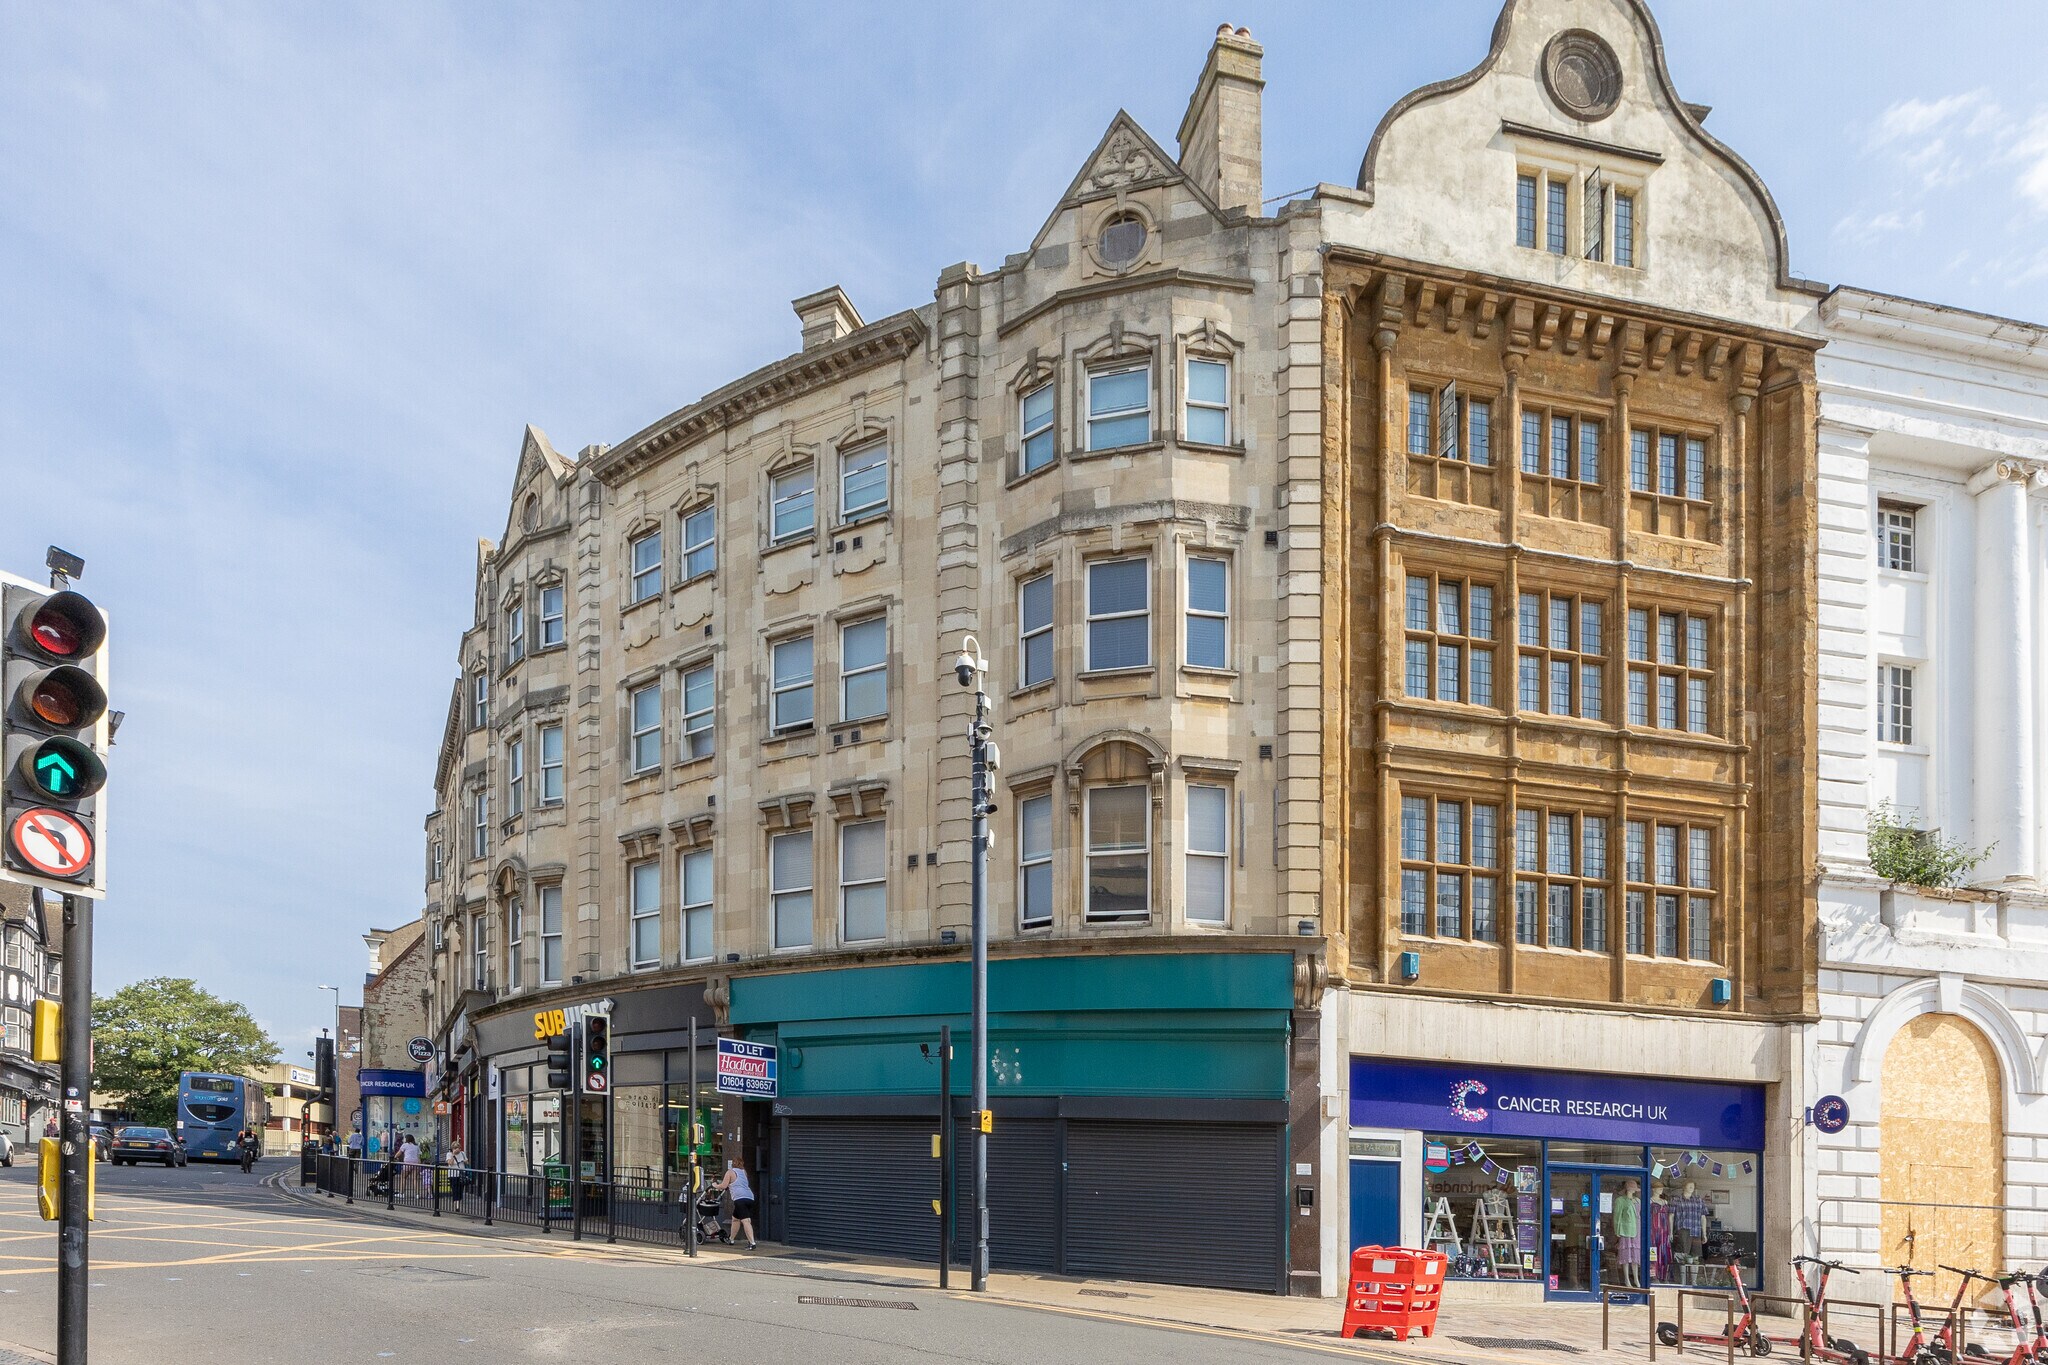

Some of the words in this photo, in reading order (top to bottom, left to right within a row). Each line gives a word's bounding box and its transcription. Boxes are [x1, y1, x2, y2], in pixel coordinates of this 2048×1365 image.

[411, 1043, 426, 1051] Tops
[413, 1049, 432, 1057] Pizza
[732, 1043, 745, 1054] TO
[746, 1045, 764, 1056] LET
[721, 1056, 766, 1073] Hadland
[722, 1076, 744, 1087] 01604
[746, 1079, 772, 1090] 639657
[1498, 1095, 1560, 1114] CANCER
[1566, 1100, 1643, 1119] RESEARCH
[1647, 1105, 1668, 1121] UK
